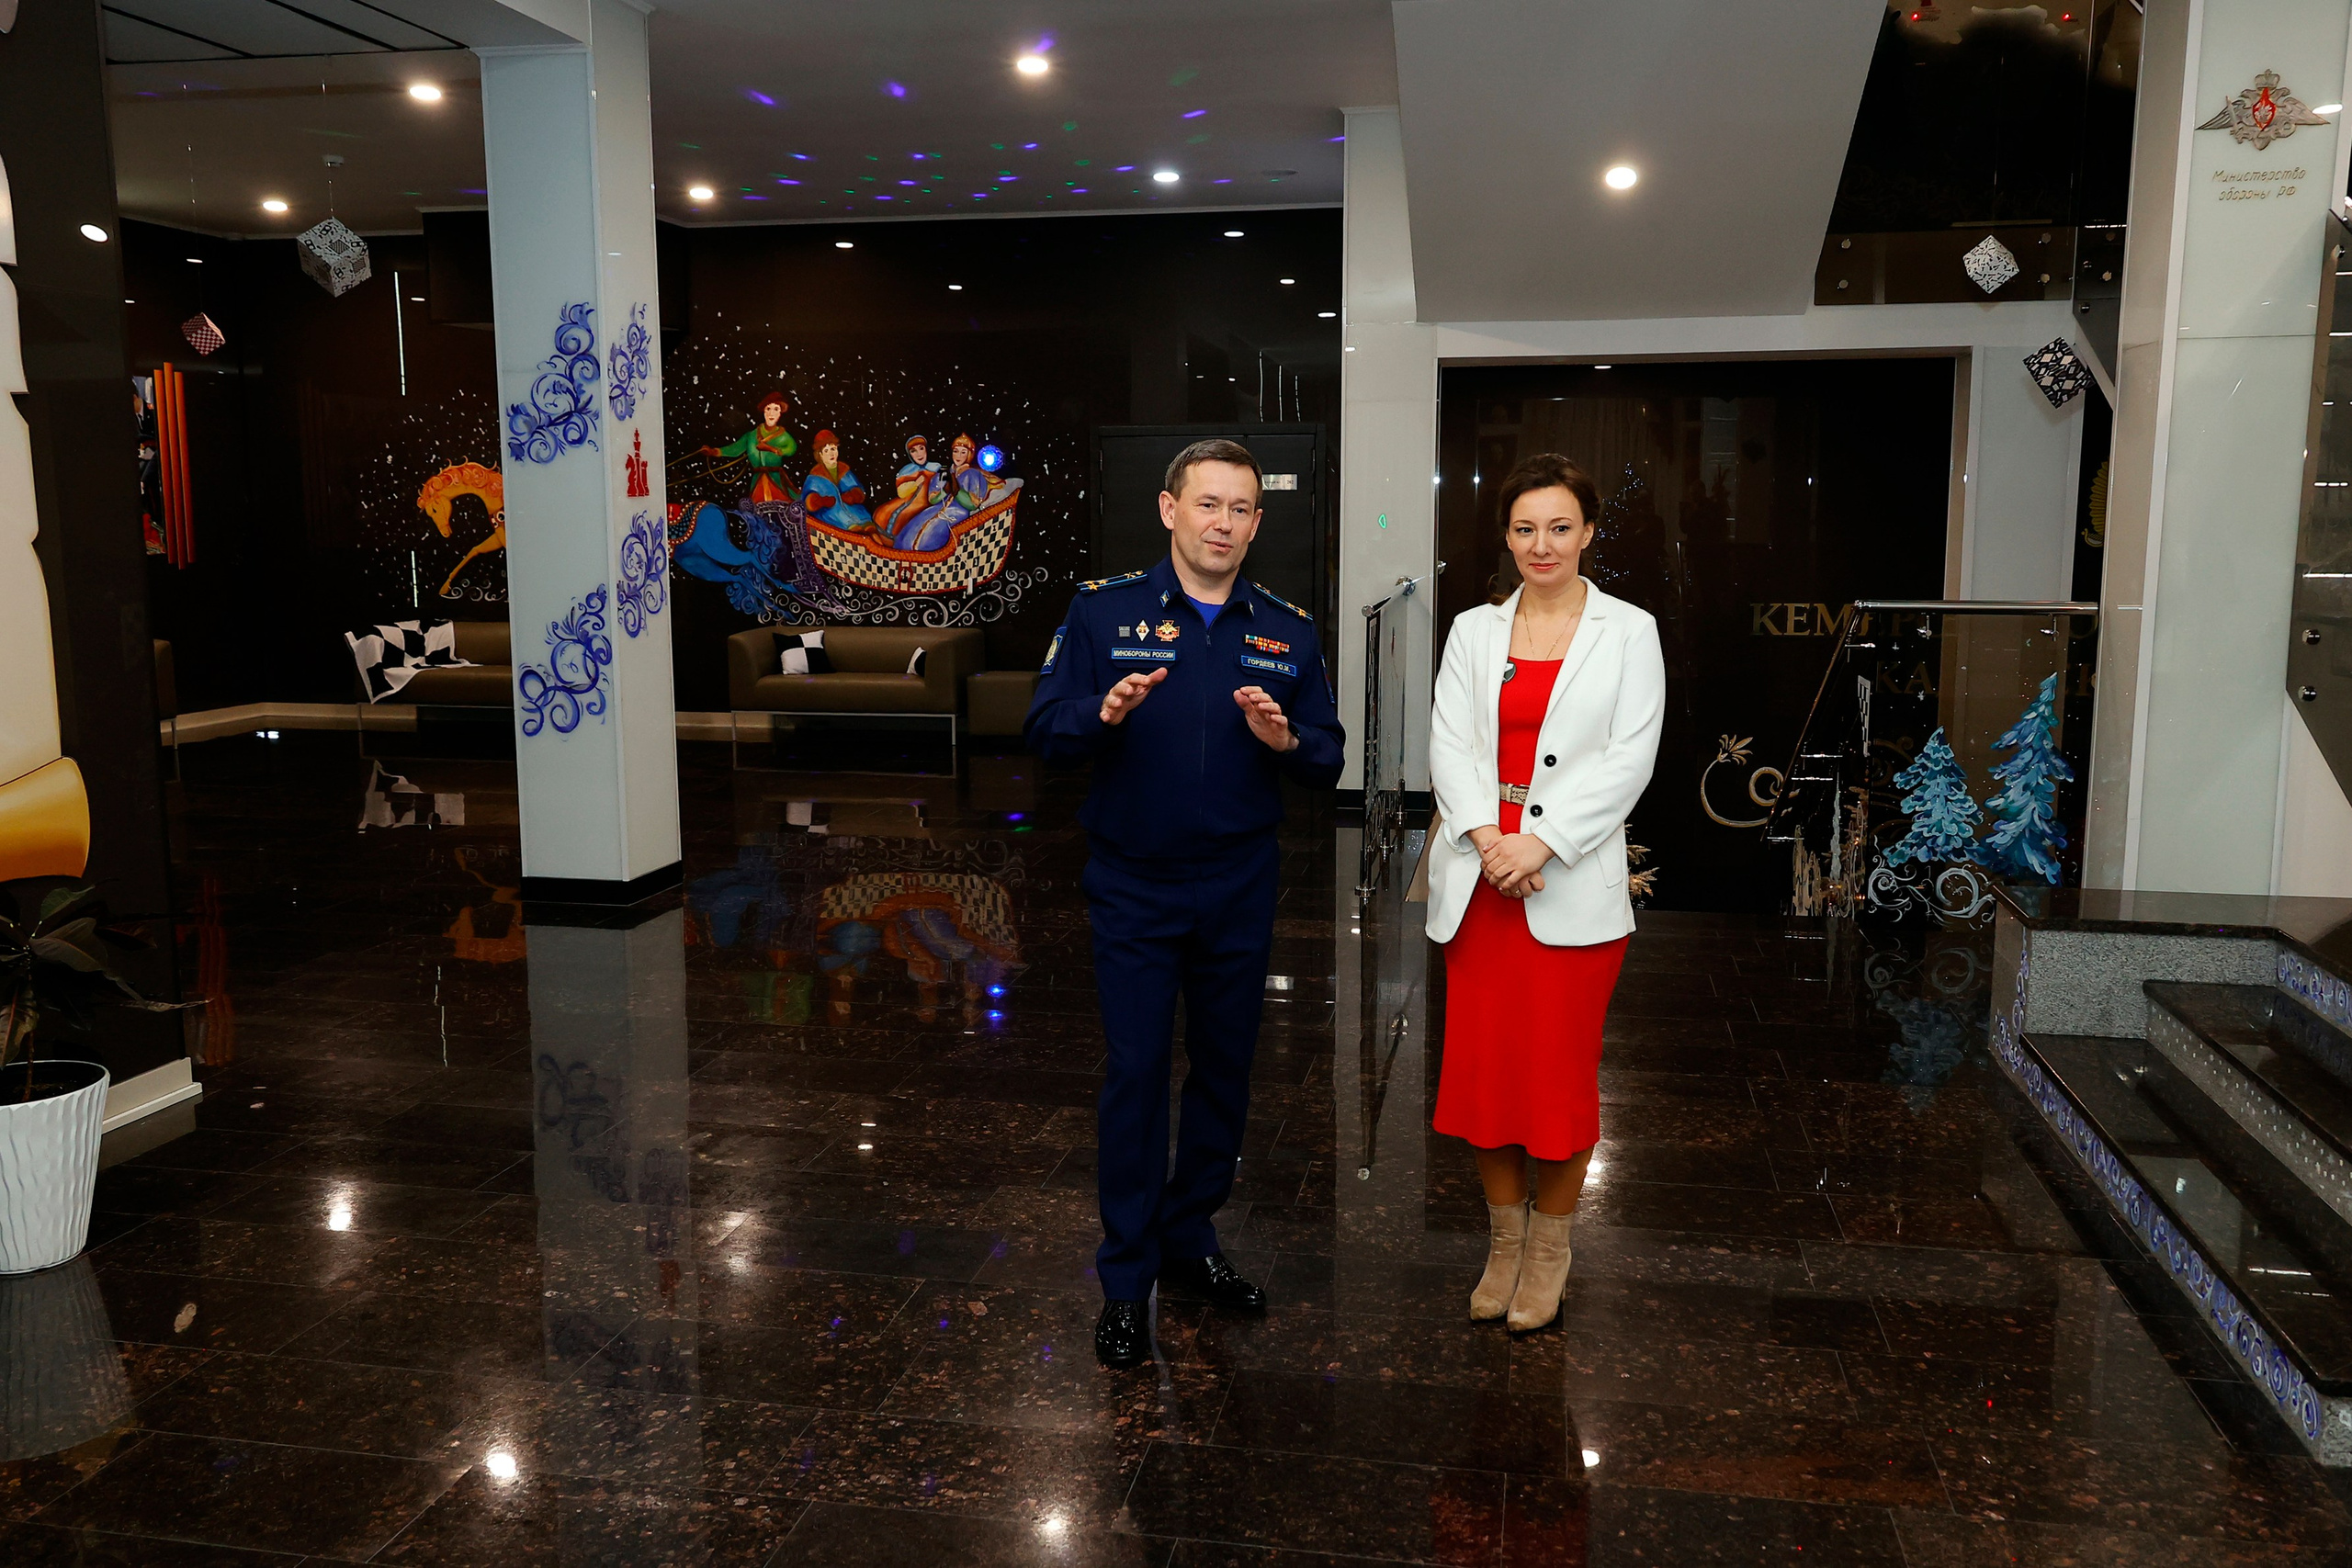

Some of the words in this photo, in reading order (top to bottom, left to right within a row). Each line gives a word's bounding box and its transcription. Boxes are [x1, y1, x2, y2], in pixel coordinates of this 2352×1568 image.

[2211, 166, 2307, 183] Министерство
[2218, 186, 2272, 201] обороны
[2276, 186, 2297, 198] РФ
[1113, 649, 1151, 658] МИНОБОРОНЫ
[1247, 659, 1276, 669] ГОРДЕЕВ
